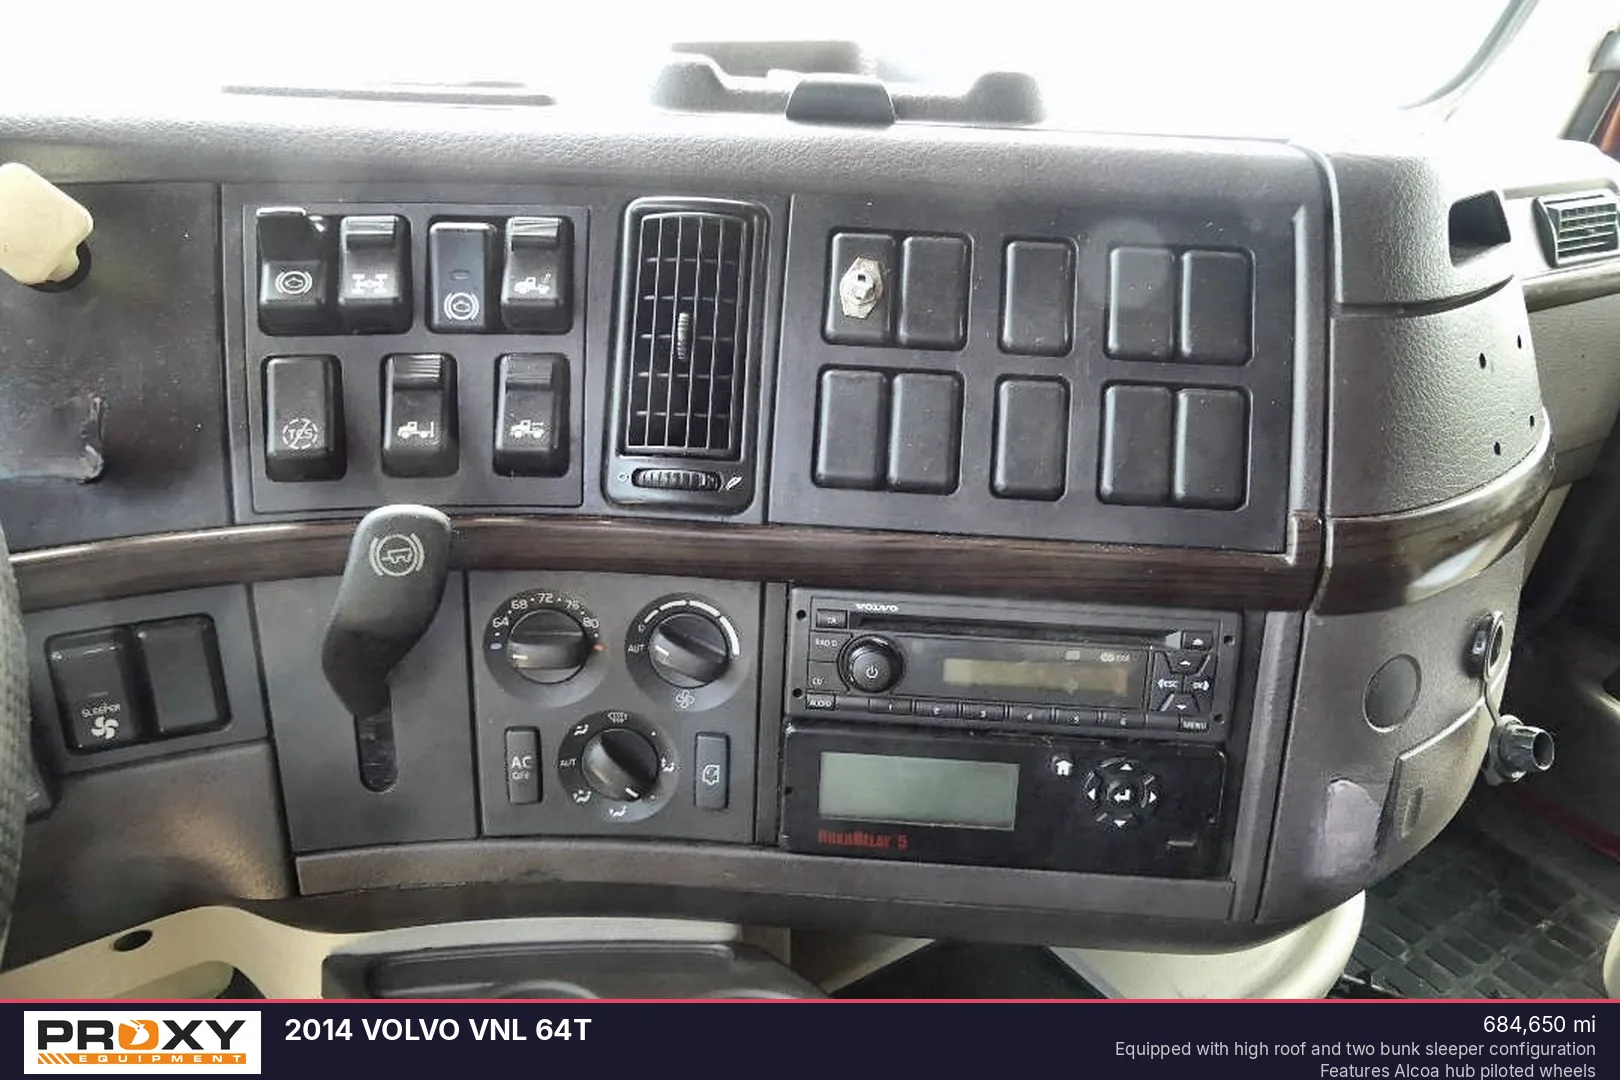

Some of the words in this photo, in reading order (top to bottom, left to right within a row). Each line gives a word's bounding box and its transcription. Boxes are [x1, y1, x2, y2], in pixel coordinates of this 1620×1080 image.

[492, 615, 509, 628] 64
[511, 599, 527, 611] 68
[537, 593, 553, 604] 72
[582, 617, 599, 629] 80
[511, 755, 532, 769] AC
